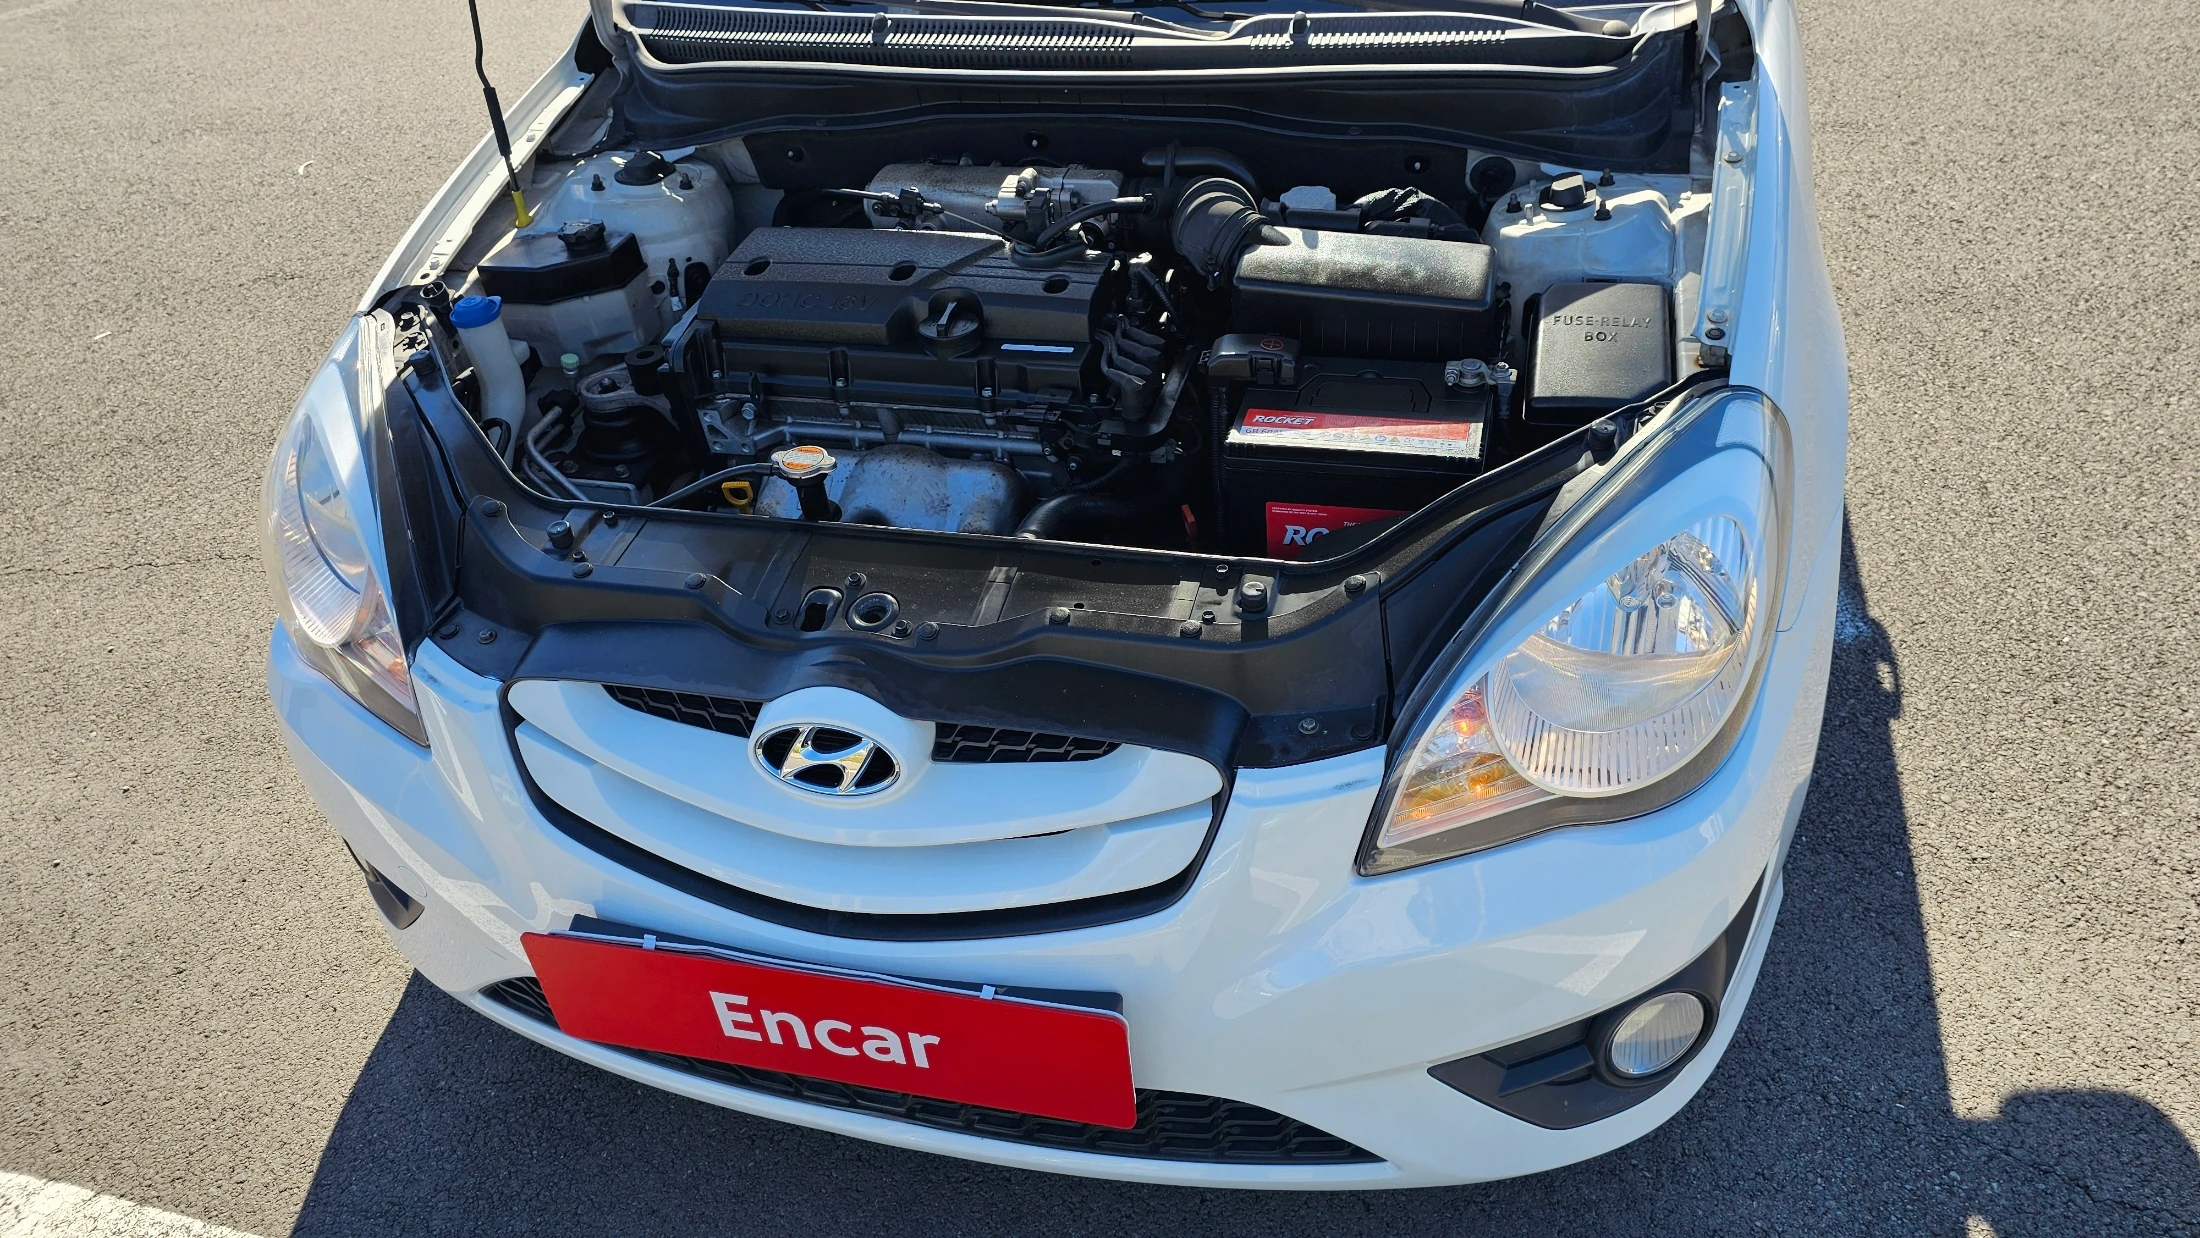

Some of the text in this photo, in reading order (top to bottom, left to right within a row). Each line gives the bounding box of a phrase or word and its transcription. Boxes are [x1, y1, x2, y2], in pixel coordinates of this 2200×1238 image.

[1584, 331, 1618, 343] BOX
[1252, 414, 1316, 426] ROCKET
[708, 990, 941, 1069] Encar
